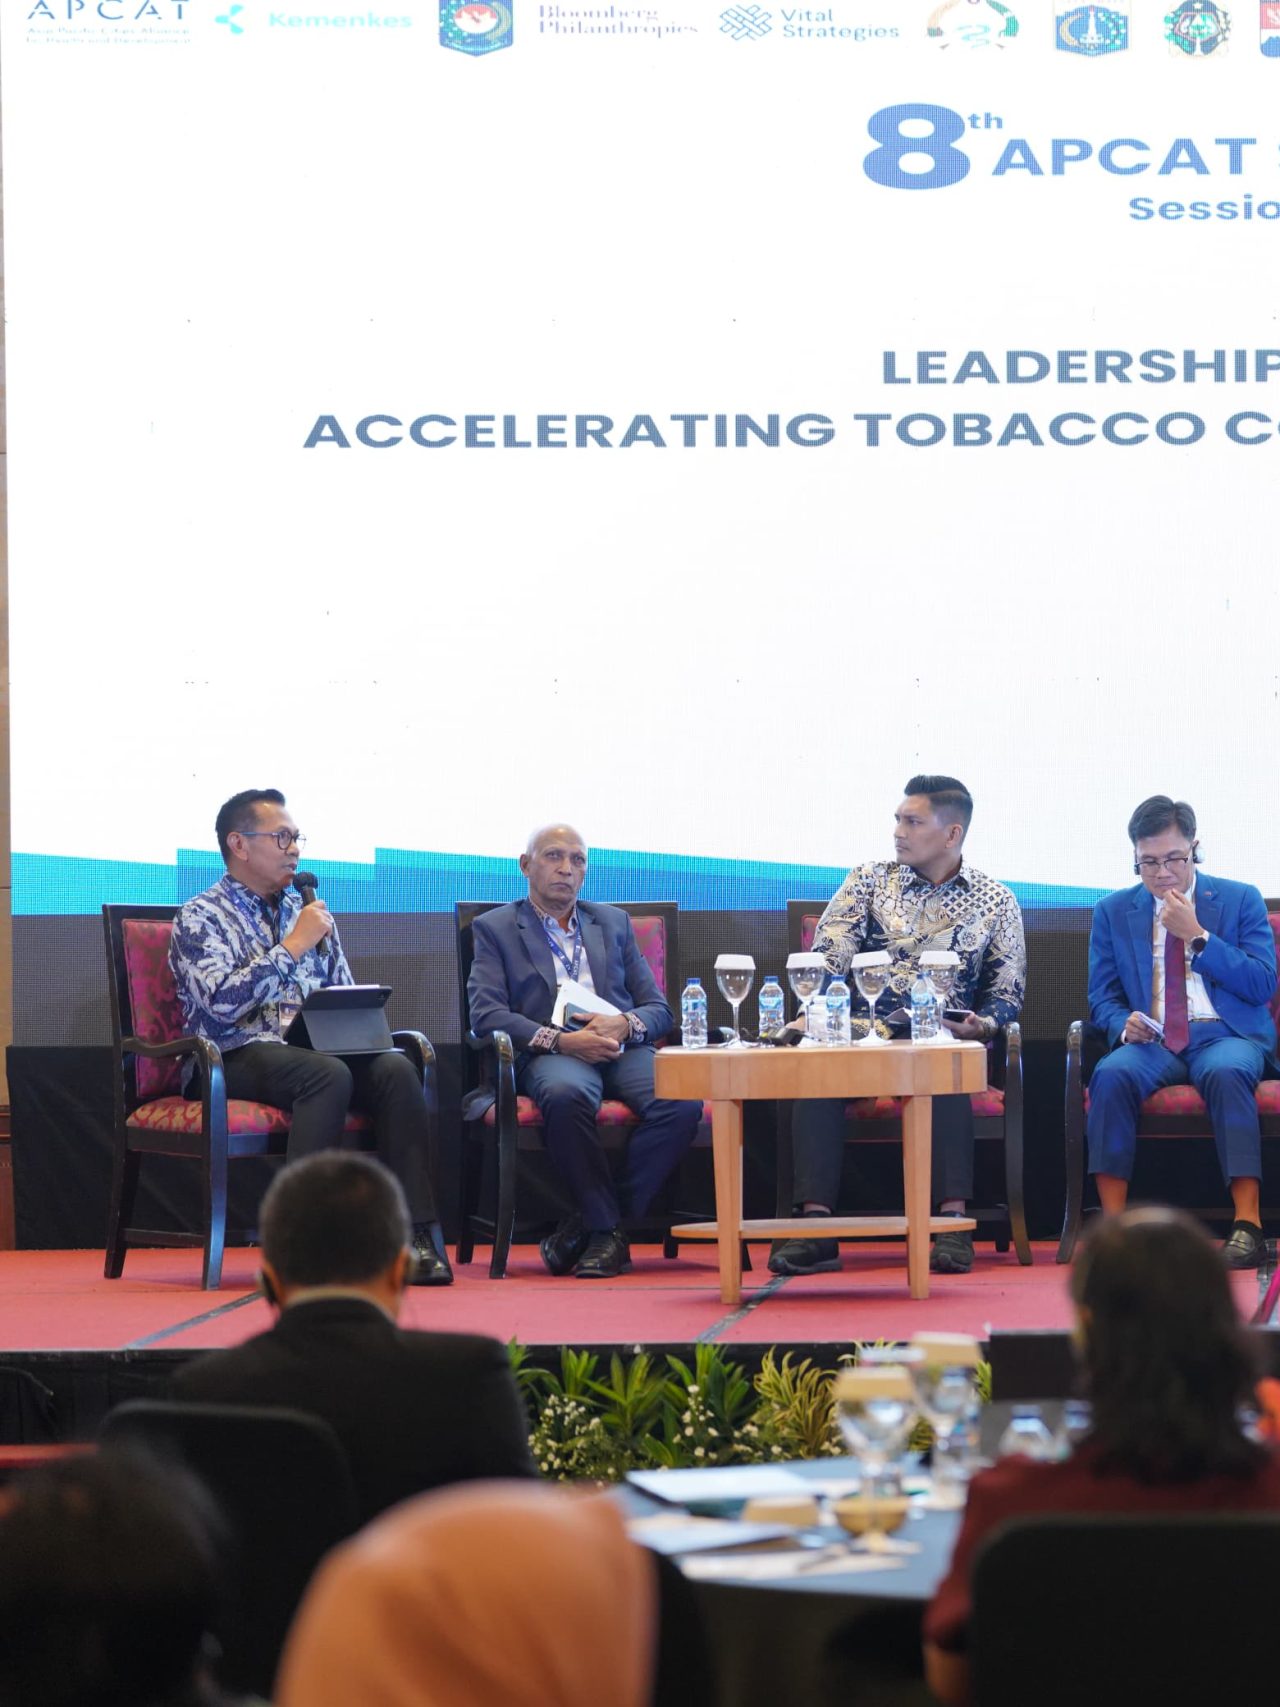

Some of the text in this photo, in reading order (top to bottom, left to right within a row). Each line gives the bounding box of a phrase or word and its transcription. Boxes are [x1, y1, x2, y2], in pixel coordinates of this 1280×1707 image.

[27, 0, 190, 20] APCAT
[539, 5, 659, 22] Bloomberg
[780, 8, 833, 22] Vital
[268, 11, 413, 28] Kemenkes
[539, 20, 698, 39] Philanthropies
[783, 24, 900, 41] Strategies
[992, 137, 1257, 176] APCAT
[303, 413, 835, 449] ACCELERATING
[853, 411, 1206, 447] TOBACCO
